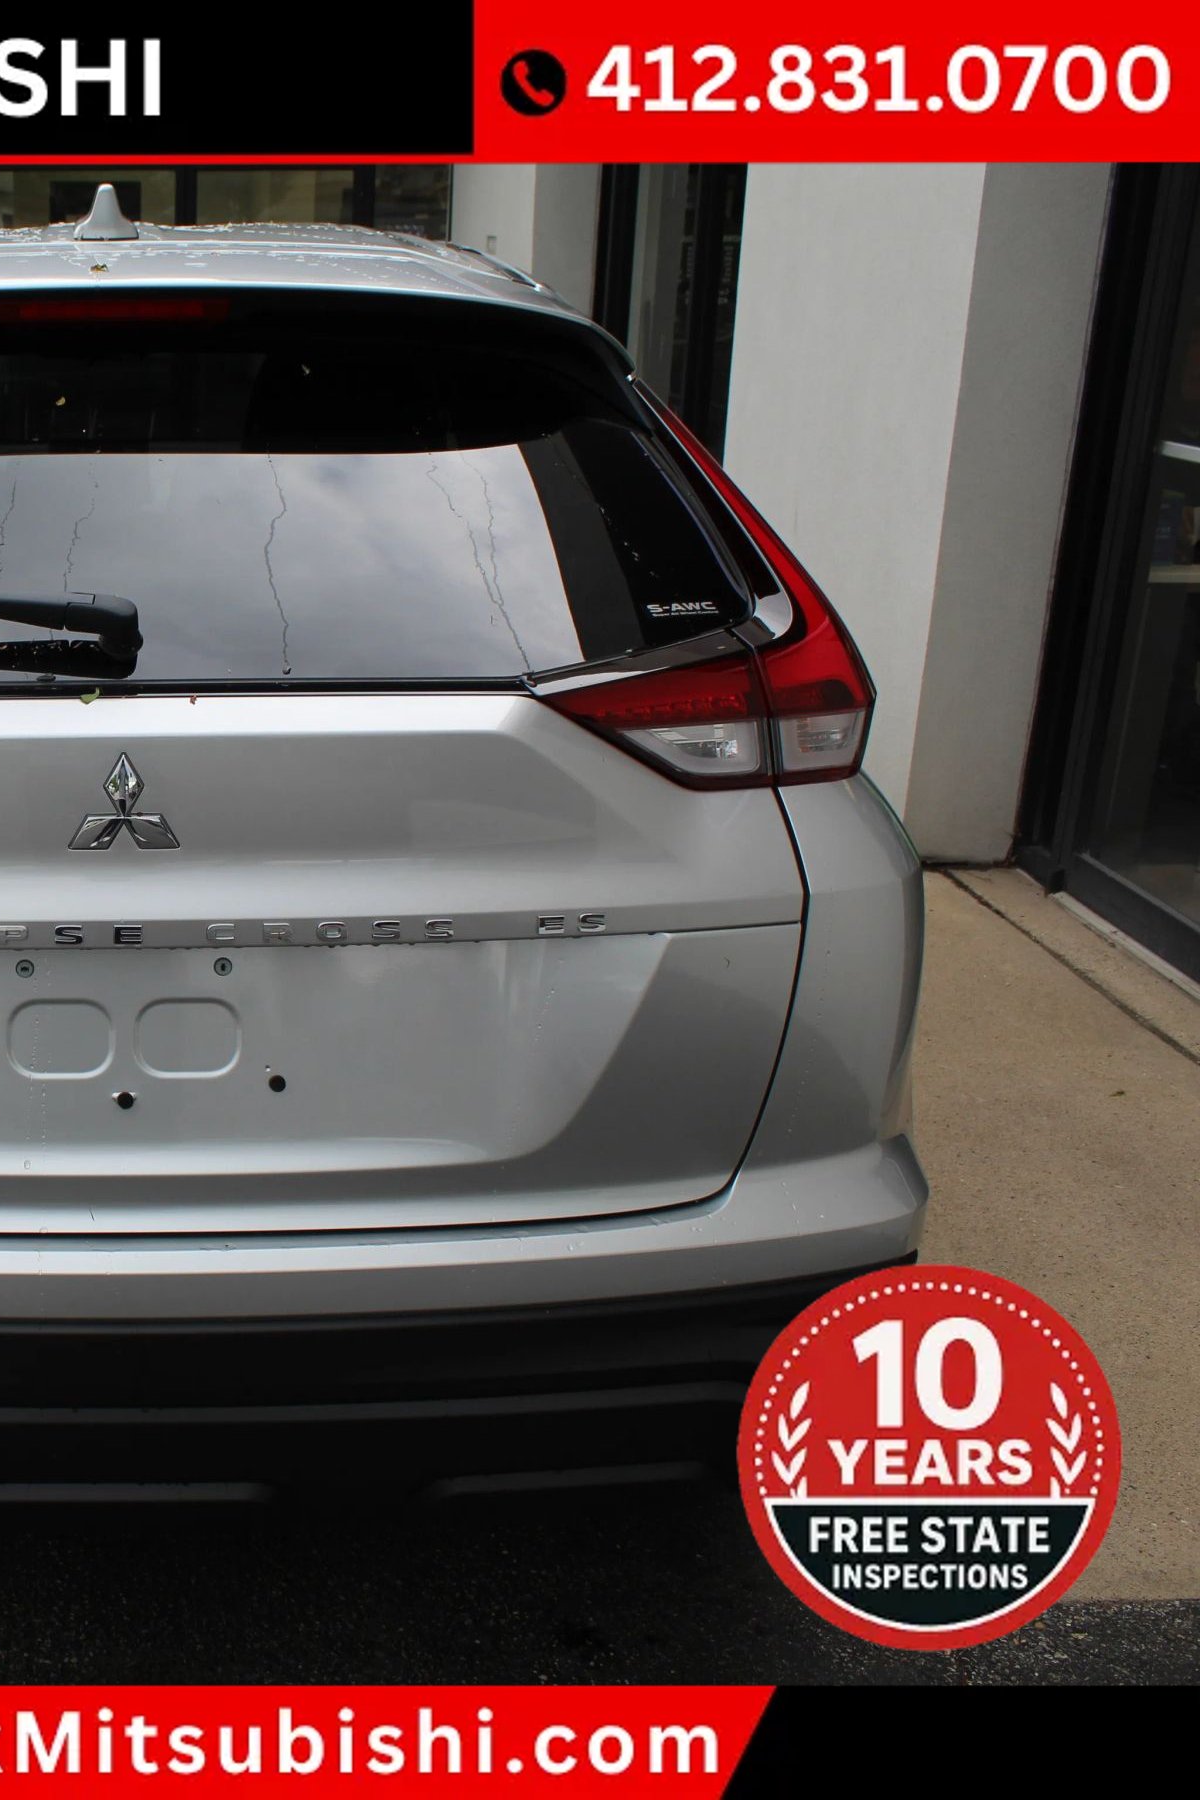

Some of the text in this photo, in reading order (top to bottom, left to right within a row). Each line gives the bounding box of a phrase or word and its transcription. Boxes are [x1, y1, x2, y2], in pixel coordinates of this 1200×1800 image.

[646, 601, 717, 613] S-AWC
[206, 918, 455, 943] CROSS
[536, 912, 606, 935] ES
